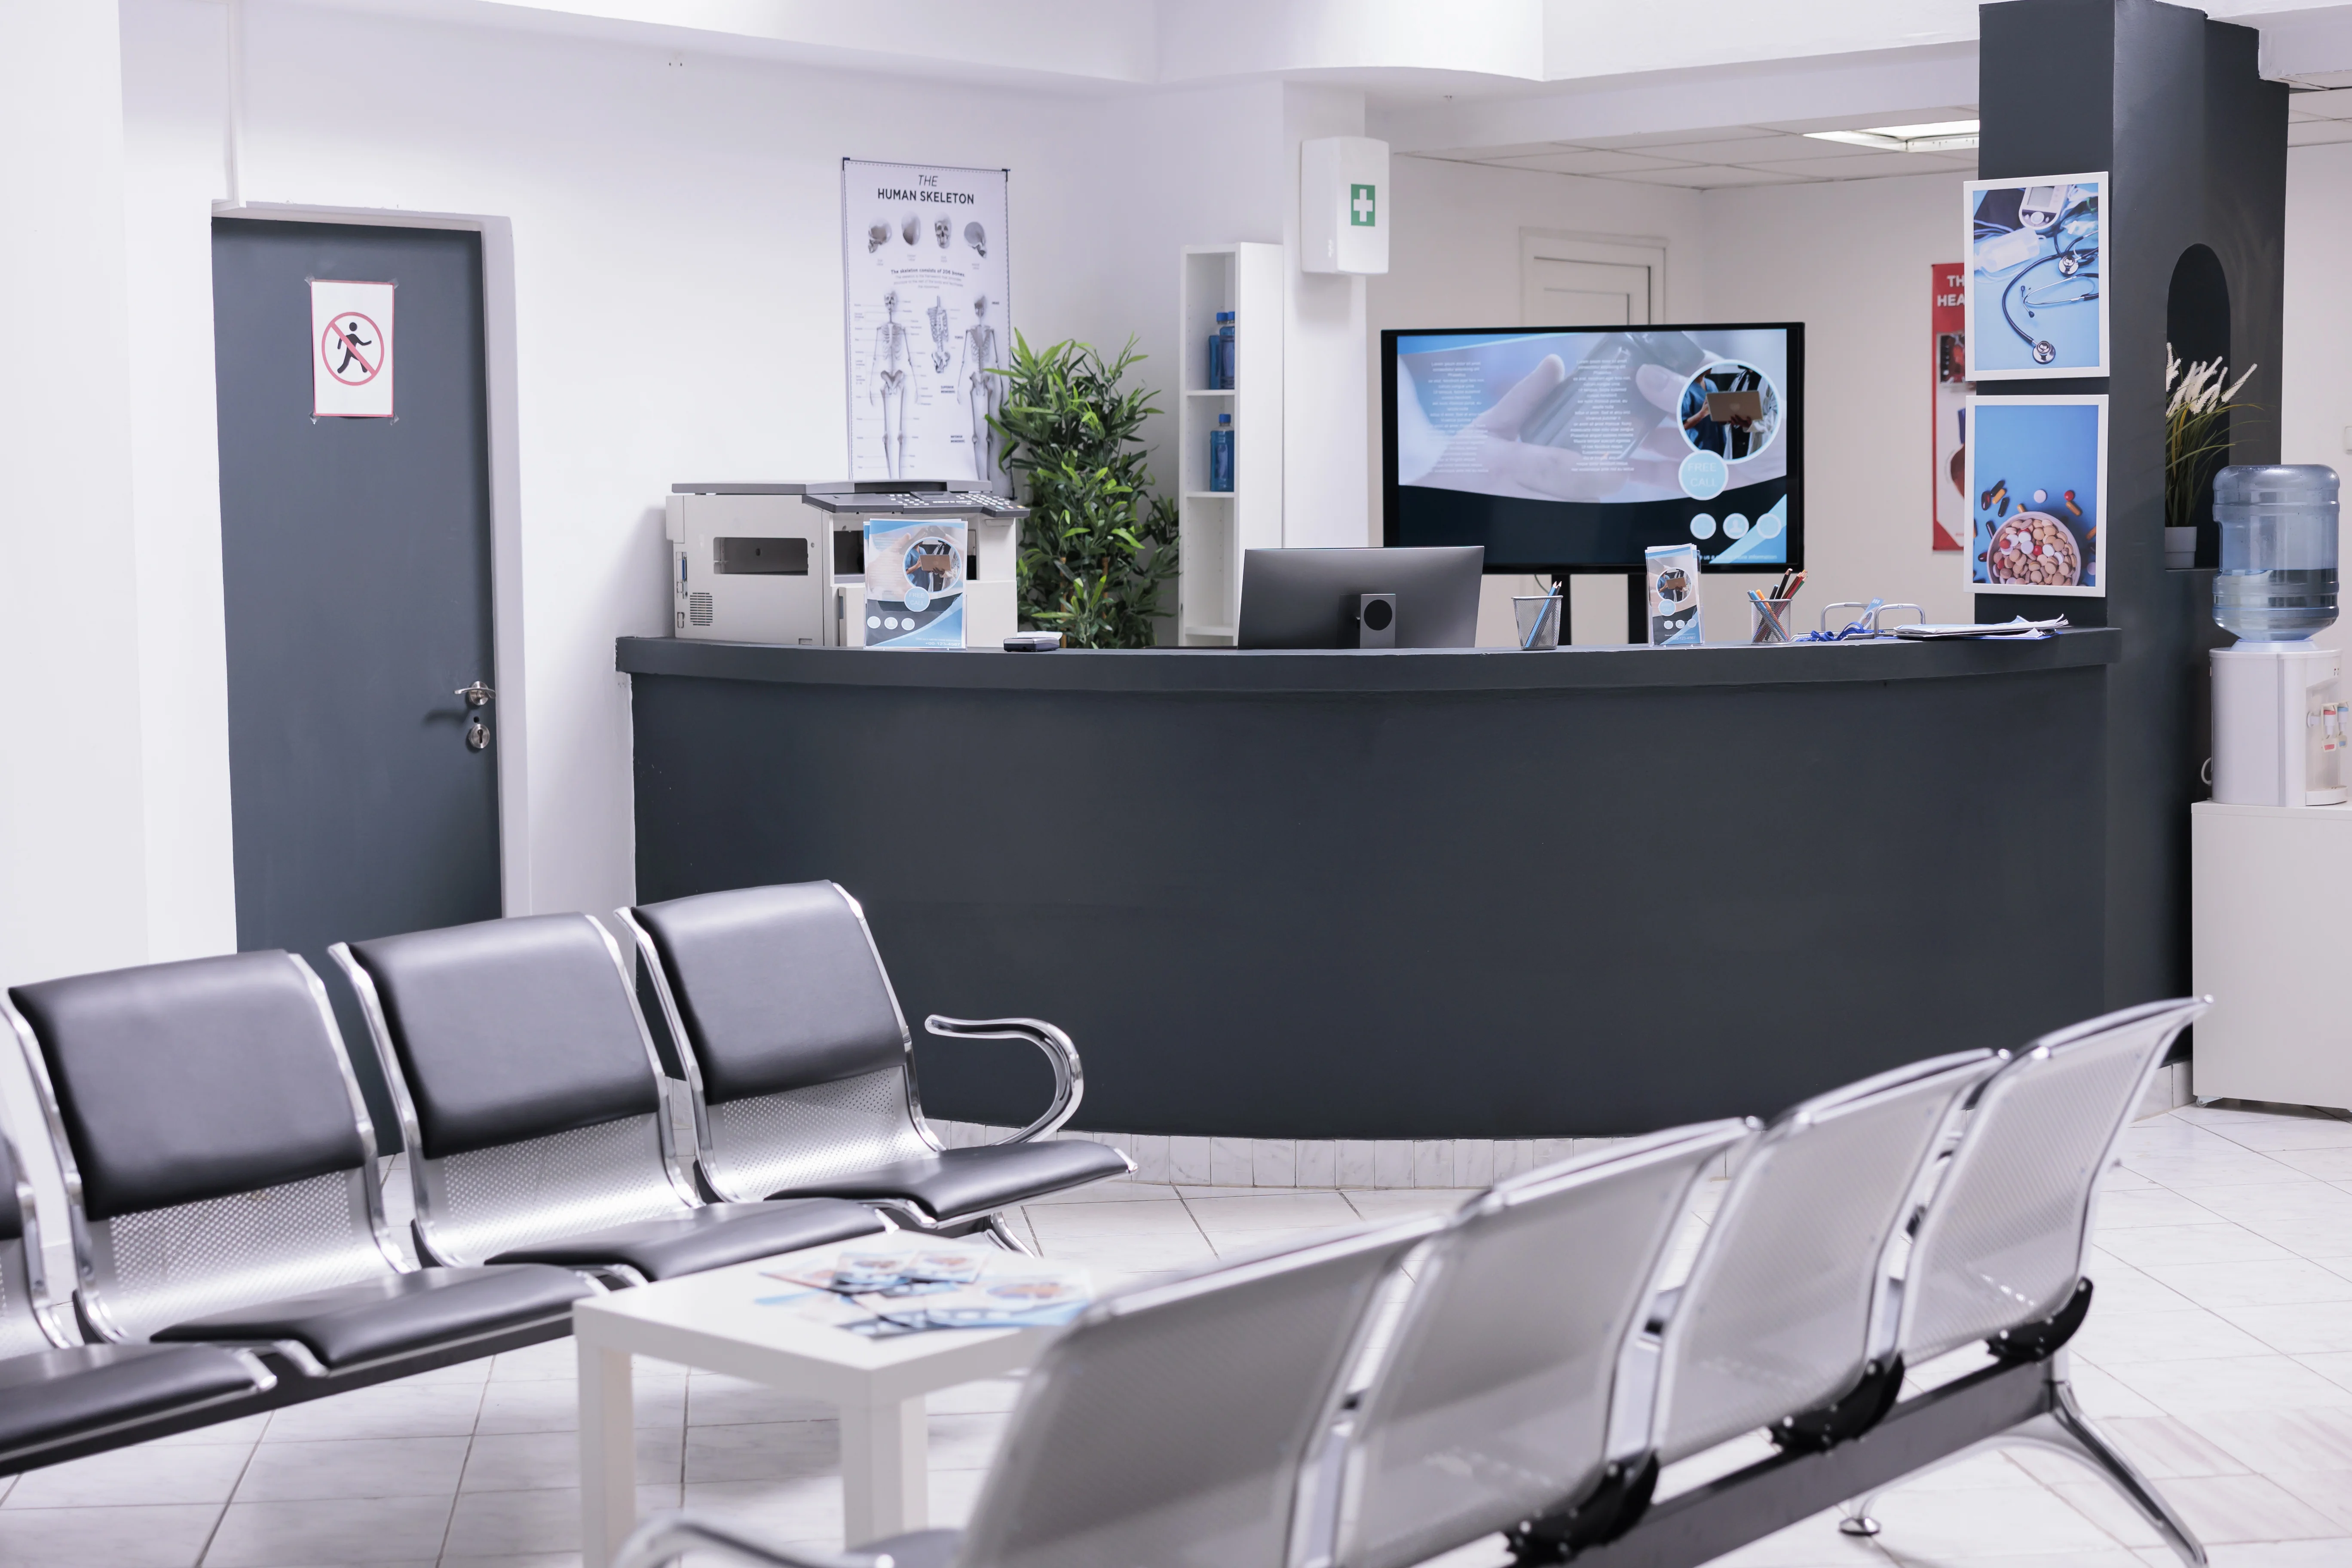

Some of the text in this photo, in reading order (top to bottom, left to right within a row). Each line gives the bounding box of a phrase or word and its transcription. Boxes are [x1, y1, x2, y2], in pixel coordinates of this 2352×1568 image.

[918, 175, 938, 187] THE
[878, 188, 974, 205] HUMAN SKELETON
[1687, 462, 1717, 472] FREE
[1690, 478, 1718, 487] CALL
